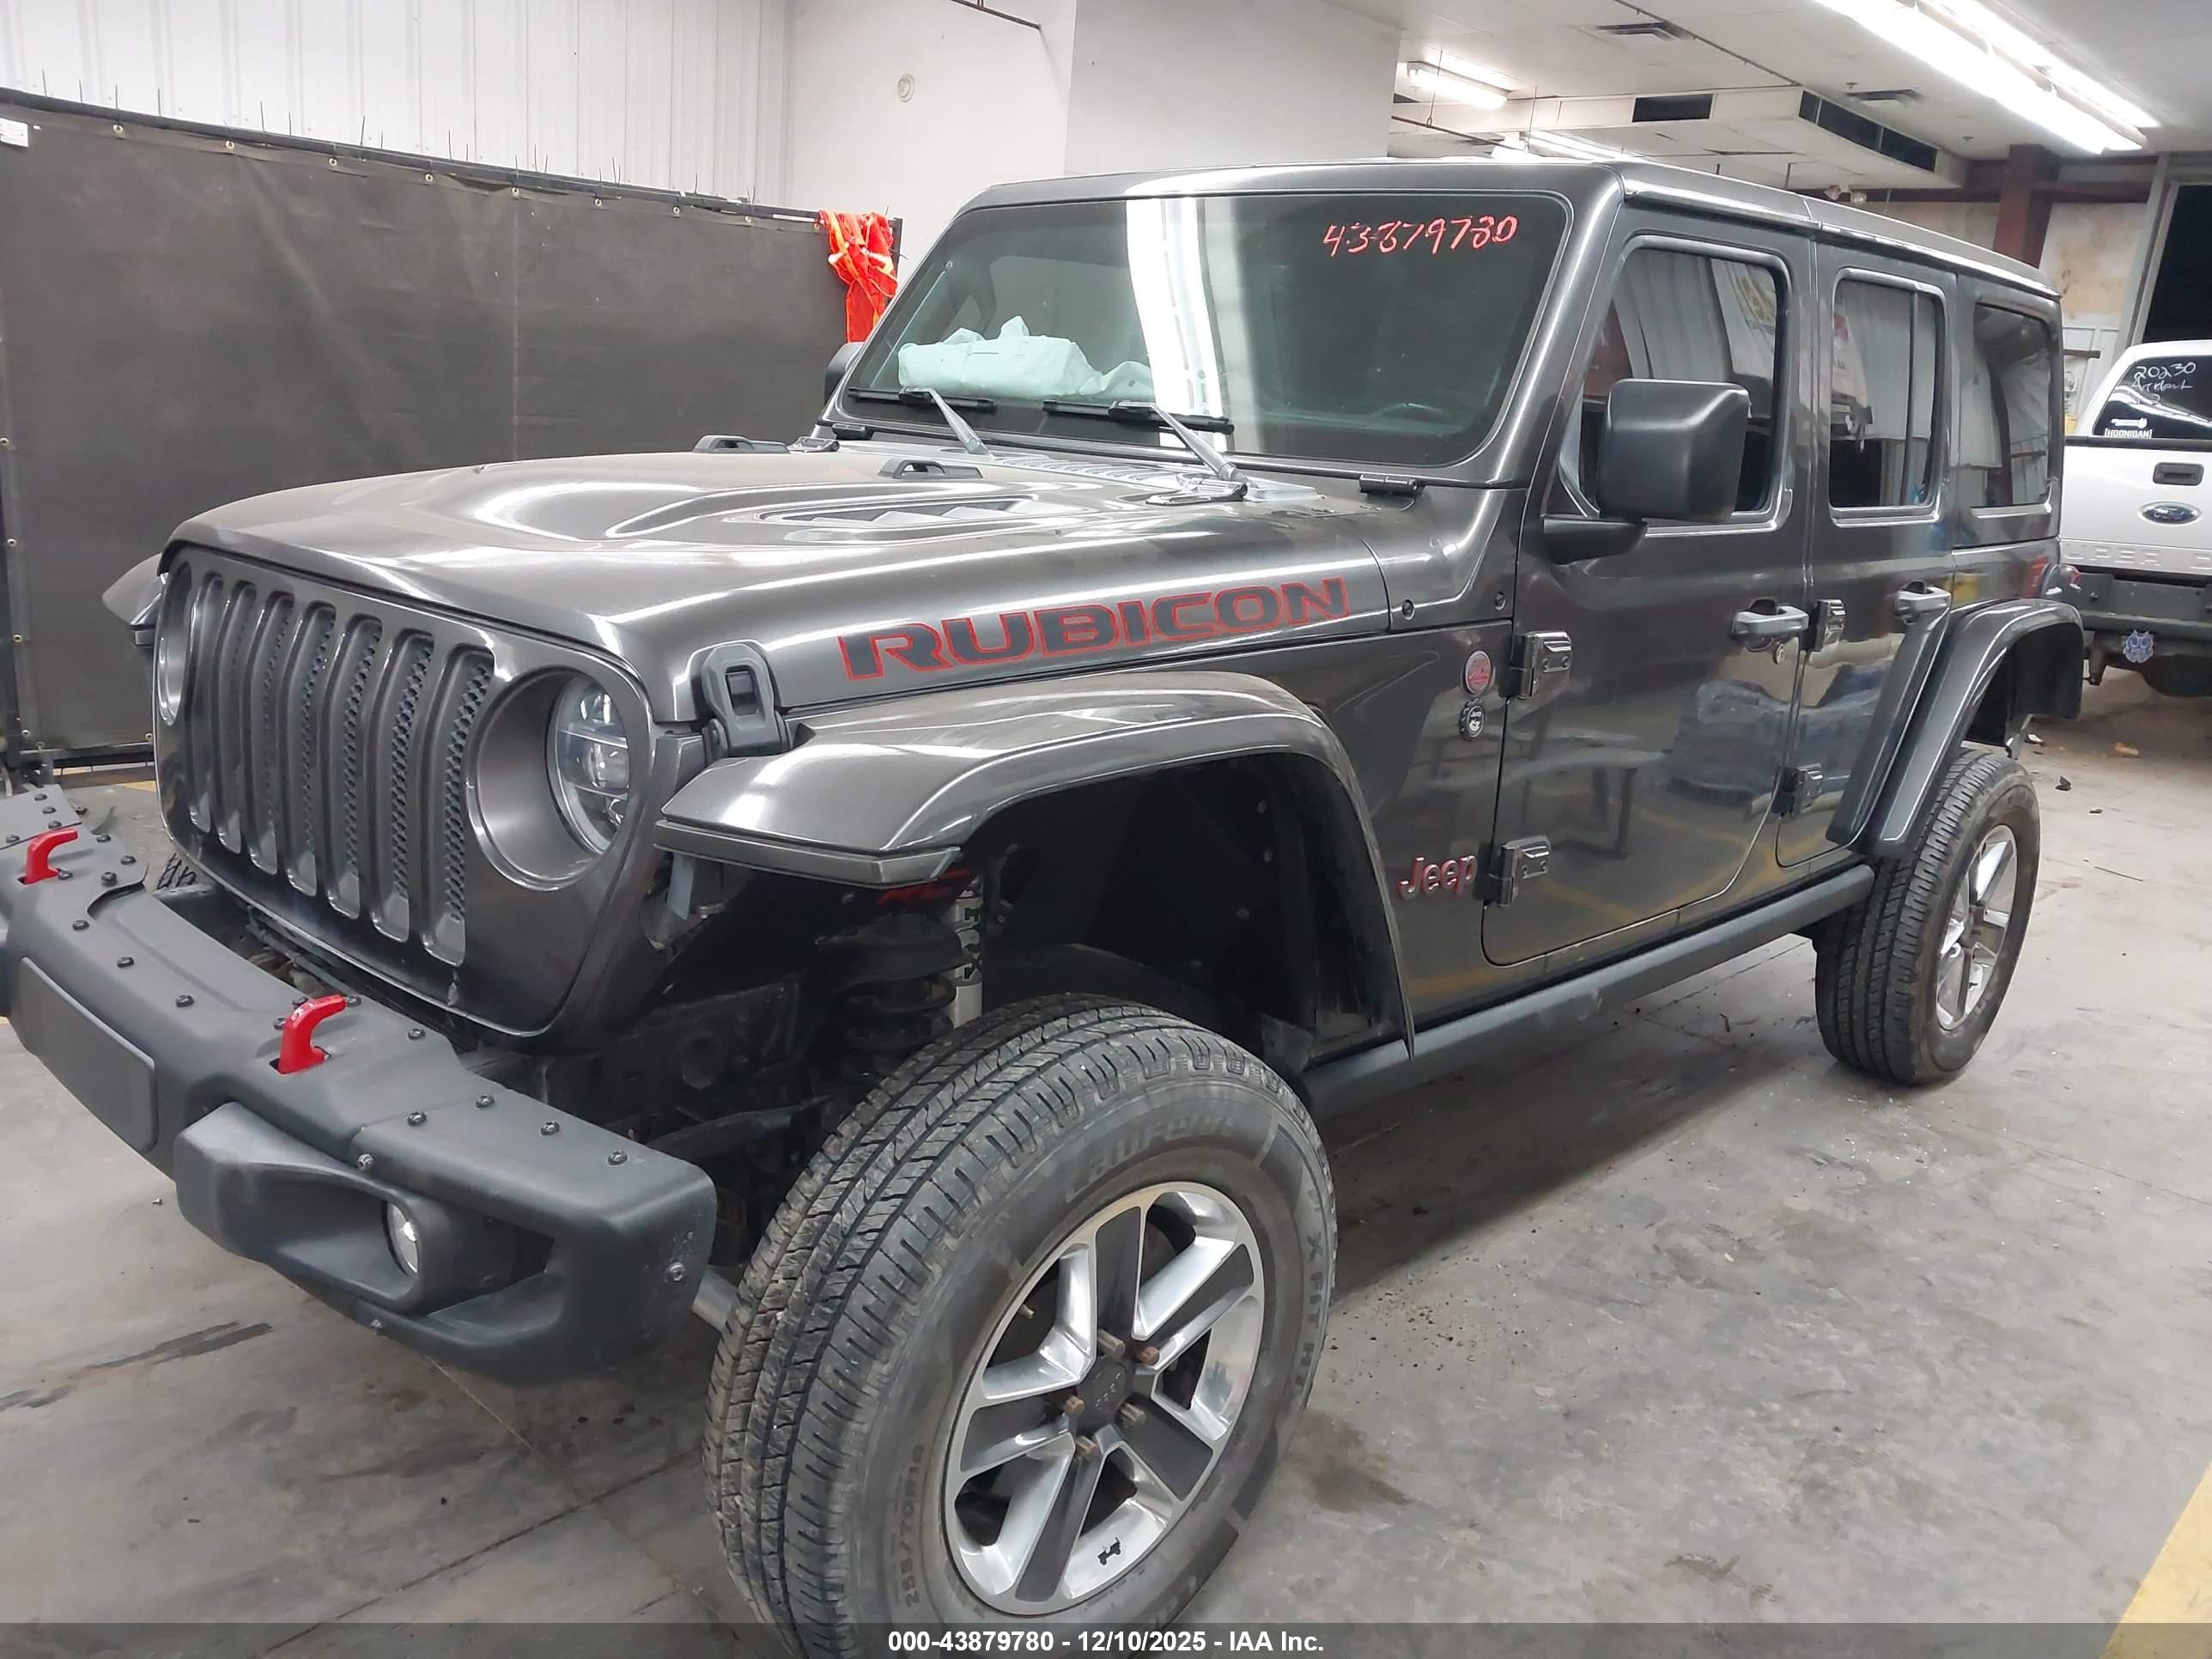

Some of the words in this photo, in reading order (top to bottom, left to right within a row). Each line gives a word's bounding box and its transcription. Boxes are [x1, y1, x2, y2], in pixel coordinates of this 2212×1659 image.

[2133, 362, 2197, 380] 20230
[2063, 543, 2162, 568] UPER
[838, 576, 1351, 681] RUBICON
[1396, 854, 1478, 901] Jeep
